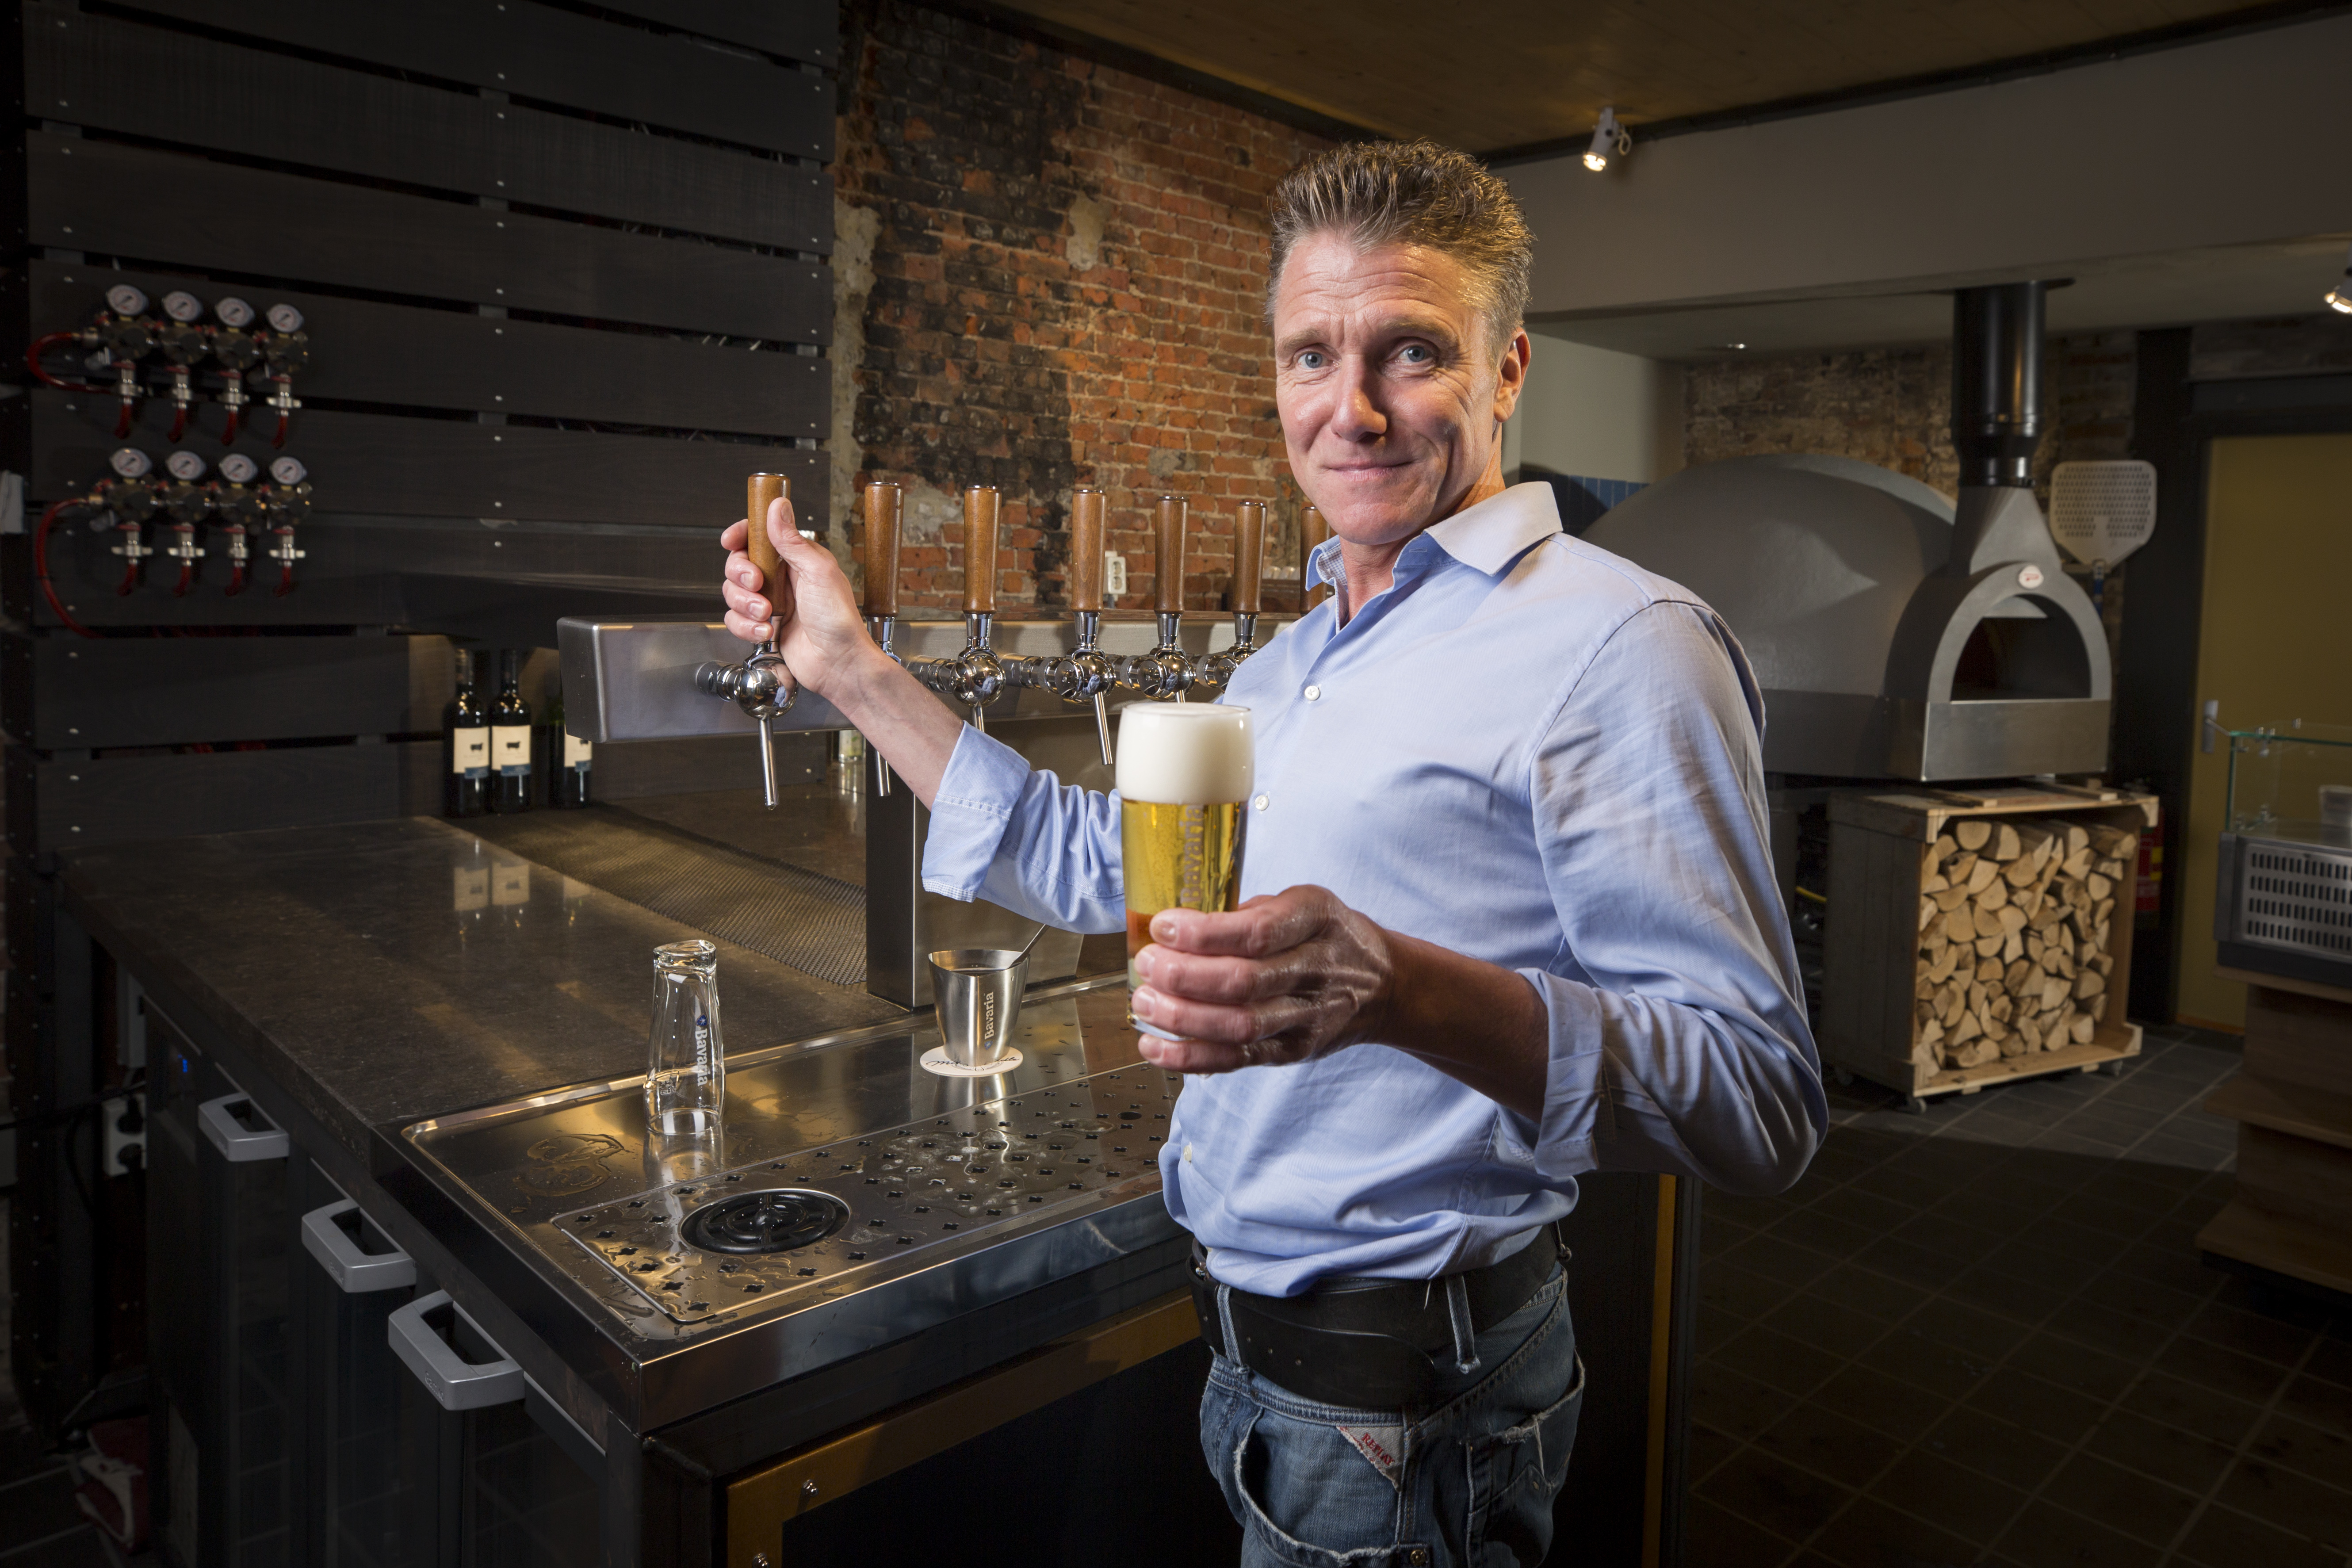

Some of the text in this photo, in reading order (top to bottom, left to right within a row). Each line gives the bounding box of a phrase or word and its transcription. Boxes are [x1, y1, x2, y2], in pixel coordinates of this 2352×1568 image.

[1178, 804, 1204, 905] Bavaria
[984, 992, 994, 1040] Bavaria
[695, 1029, 711, 1086] Bavaria
[1361, 1433, 1395, 1466] REPLAY
